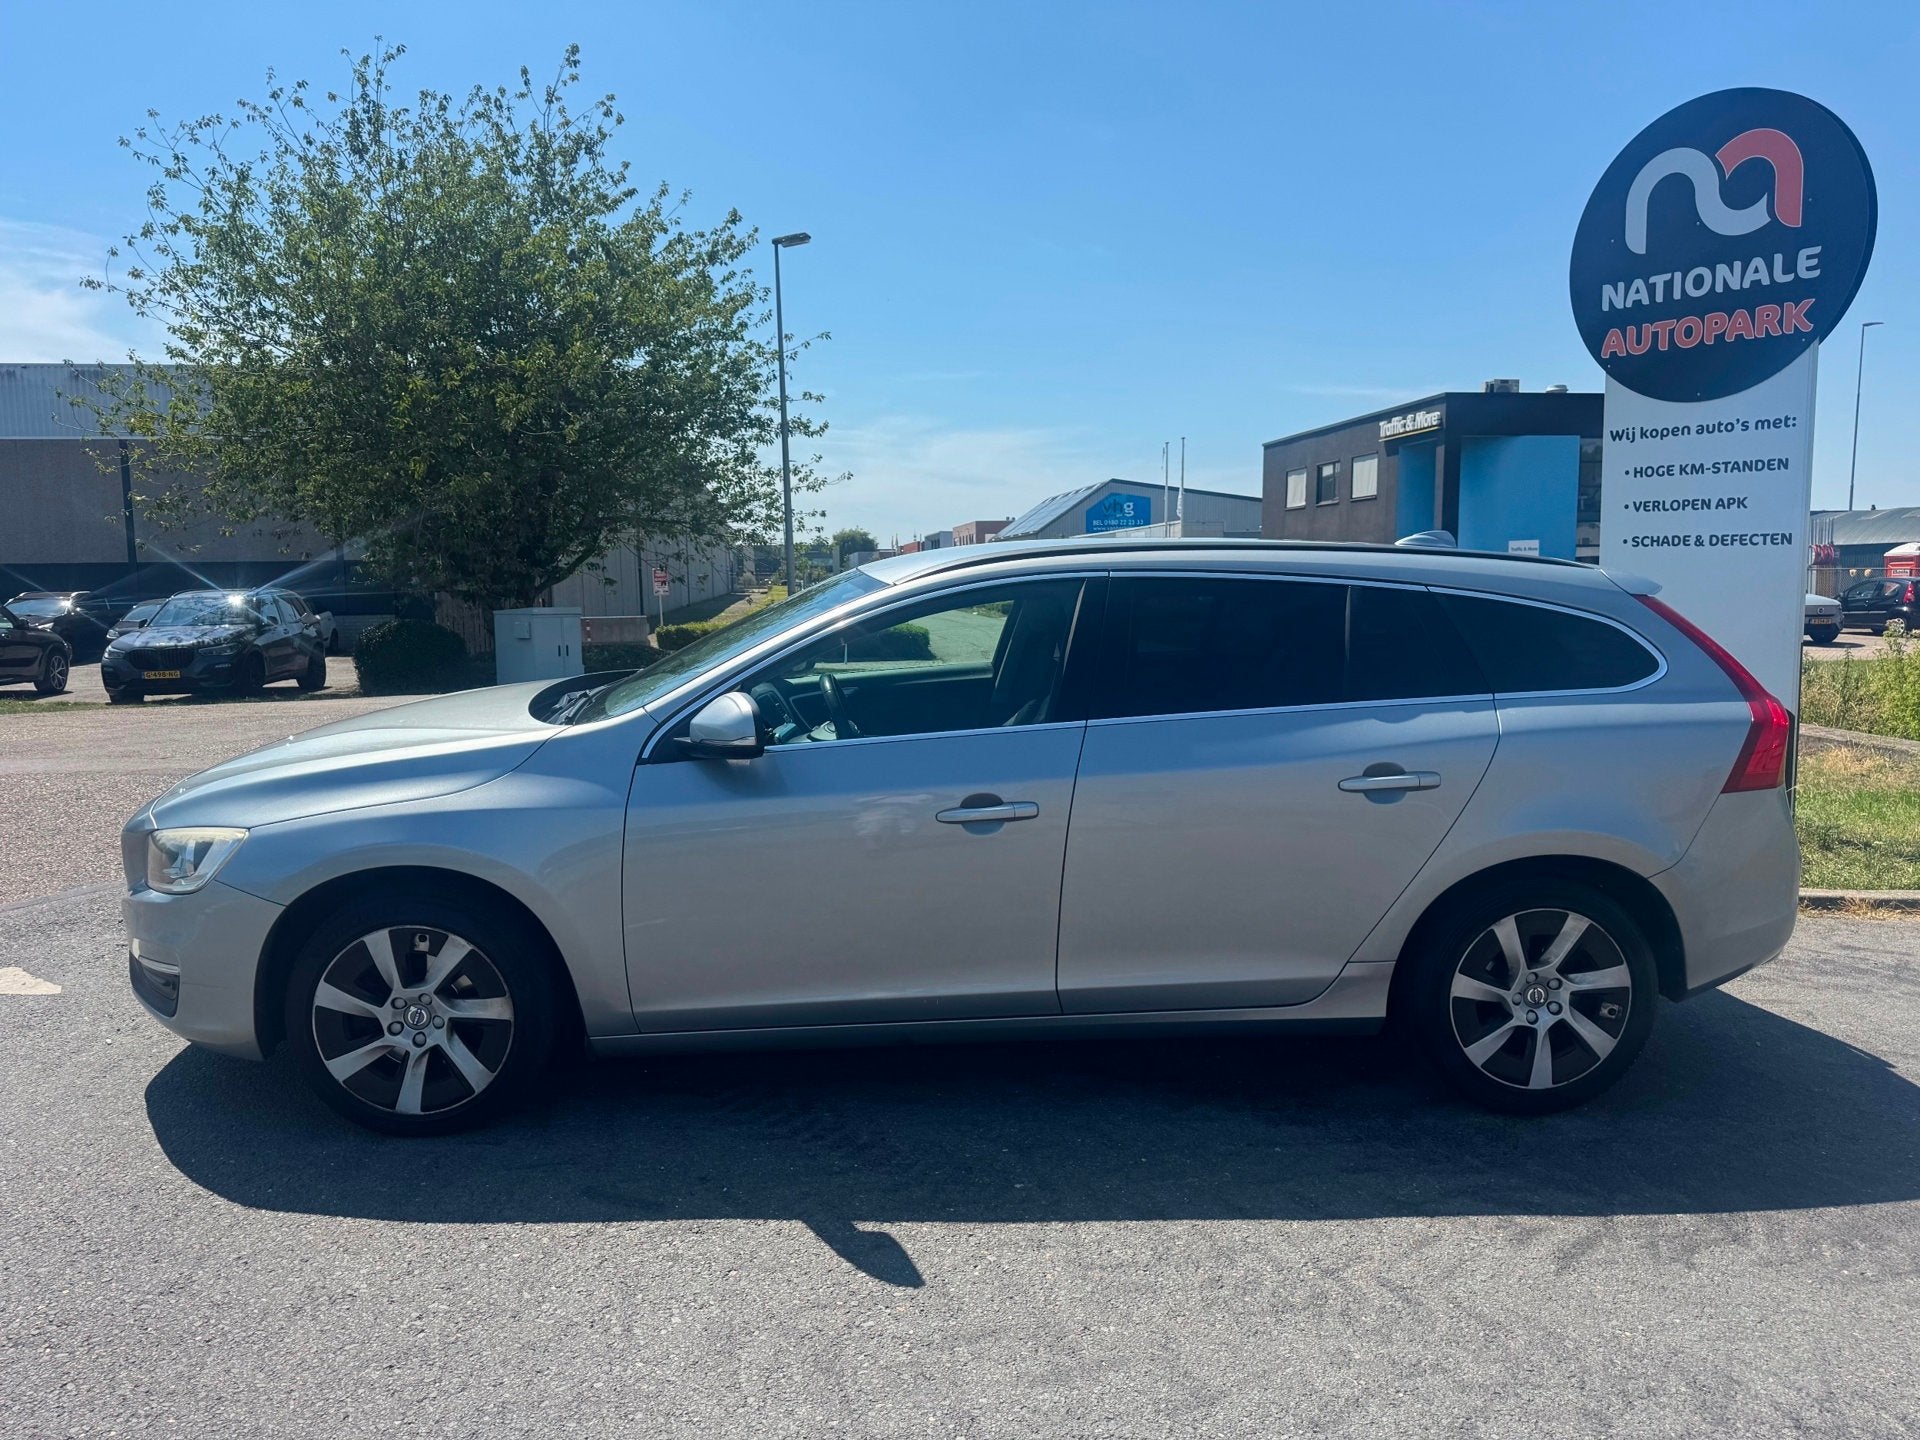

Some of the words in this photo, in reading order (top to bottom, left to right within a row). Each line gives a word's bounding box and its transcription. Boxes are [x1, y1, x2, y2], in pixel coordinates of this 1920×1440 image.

[1601, 246, 1822, 312] NATIONALE
[1601, 298, 1816, 359] AUTOPARK
[1379, 416, 1406, 437] Traffic
[1406, 414, 1415, 431] &
[1415, 411, 1440, 429] More
[1609, 427, 1636, 444] Wij
[1639, 424, 1691, 441] kopen
[1695, 417, 1750, 436] auto's
[1754, 414, 1797, 431] met:
[1633, 464, 1676, 478] HOGE
[1678, 457, 1790, 476] KM-STANDEN
[1632, 498, 1712, 513] VERLOPEN
[1714, 496, 1749, 510] APK
[1631, 534, 1692, 548] SCHADE
[1693, 534, 1706, 548] &
[1708, 532, 1793, 547] DEFECTEN
